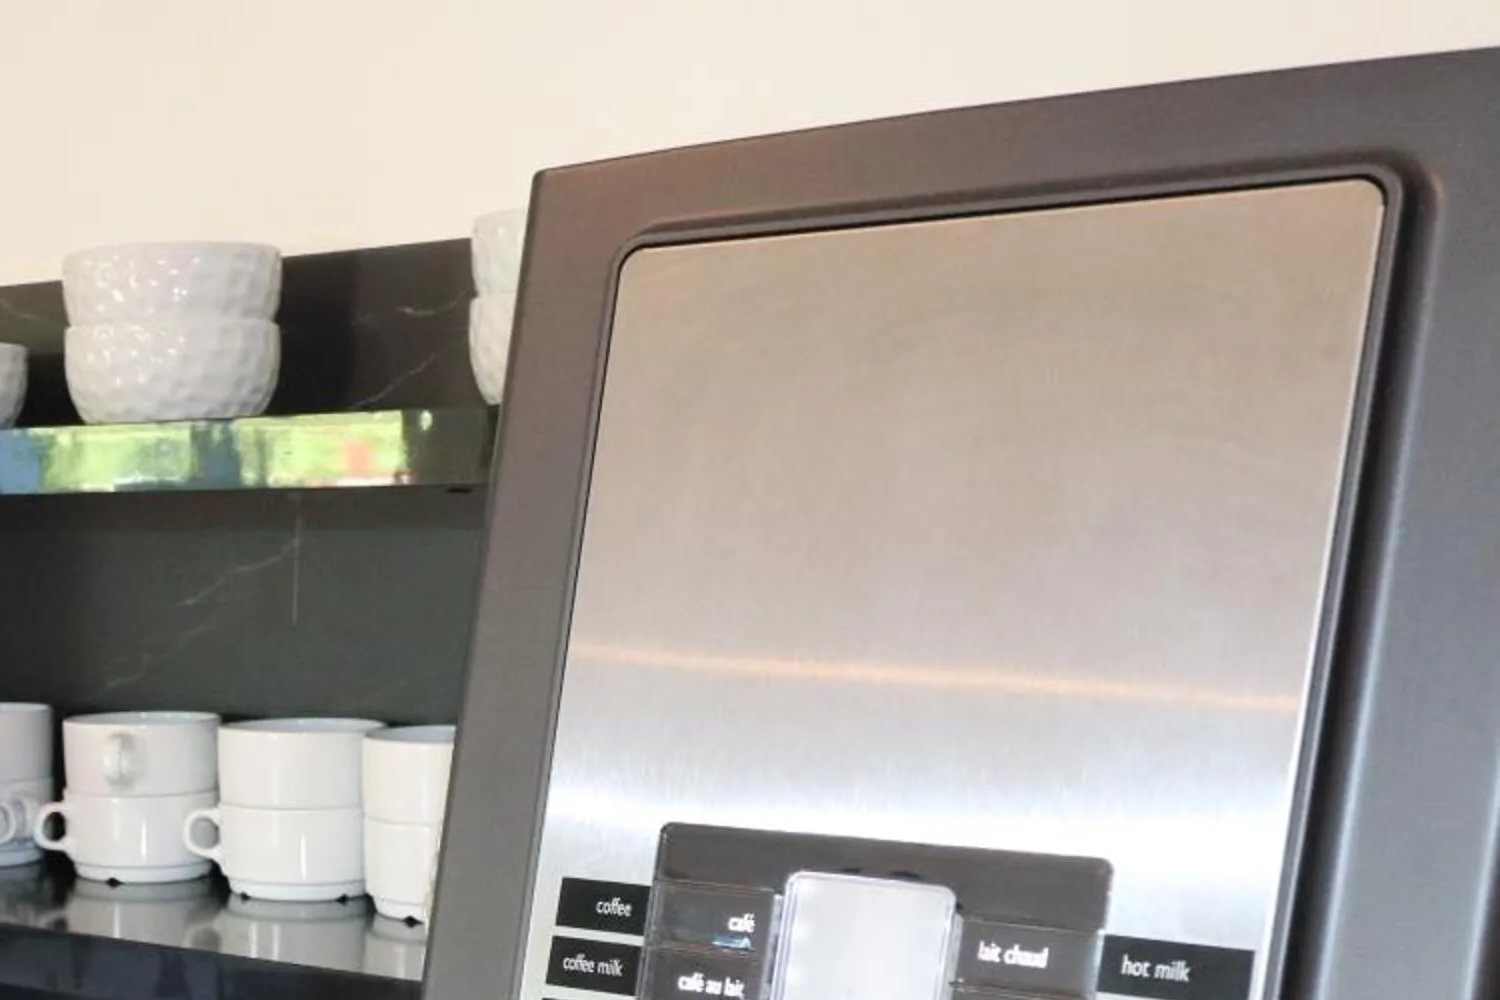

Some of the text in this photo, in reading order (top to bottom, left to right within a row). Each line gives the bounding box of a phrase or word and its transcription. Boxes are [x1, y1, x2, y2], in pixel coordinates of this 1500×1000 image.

[596, 898, 632, 917] coffee
[728, 913, 755, 933] café
[563, 953, 623, 976] coffee milk
[977, 941, 1048, 968] lait chaud
[1121, 954, 1191, 983] hot milk
[678, 972, 704, 993] café
[706, 980, 722, 995] au
